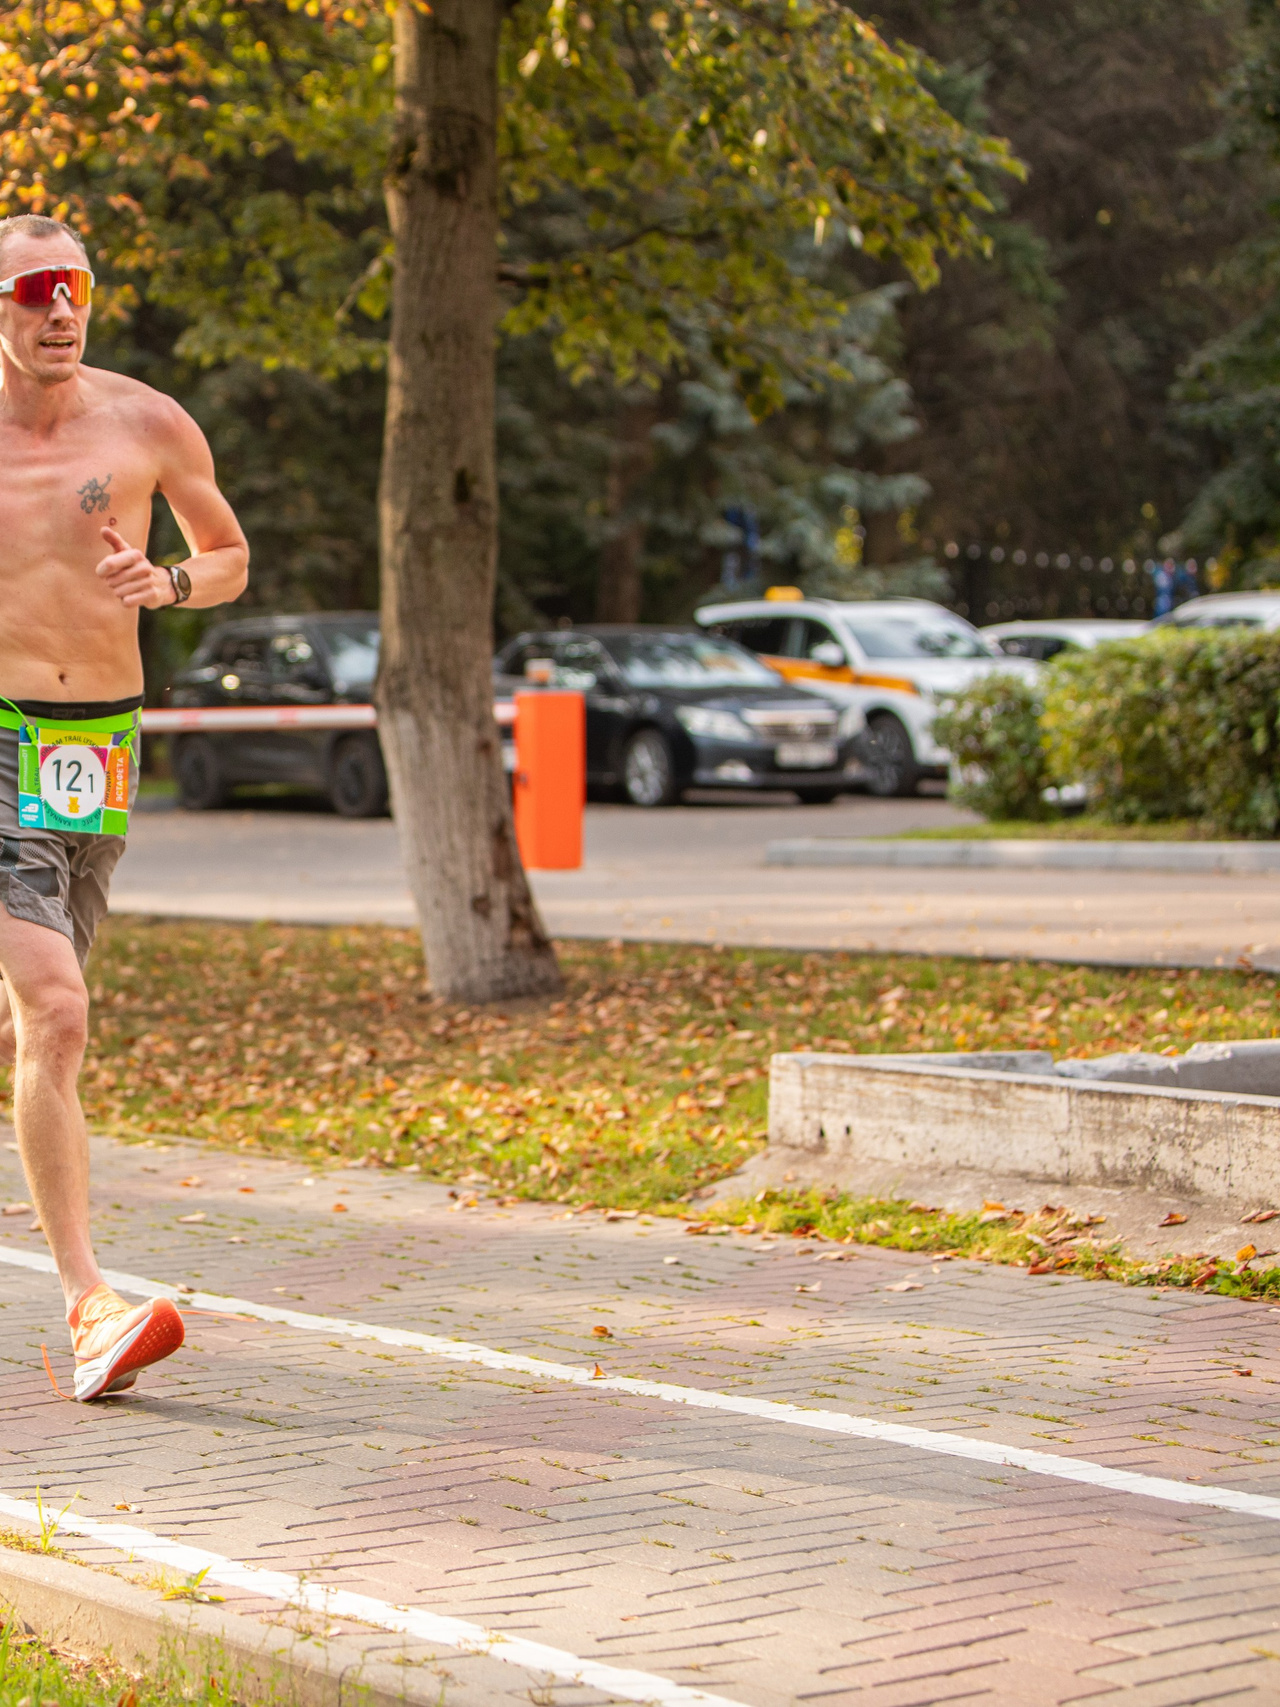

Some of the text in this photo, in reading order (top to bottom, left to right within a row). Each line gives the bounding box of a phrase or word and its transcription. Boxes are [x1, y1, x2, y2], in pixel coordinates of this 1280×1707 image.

[41, 735, 105, 760] DREAM TRAIL LYSKOVO
[116, 757, 124, 802] ЭСТАФЕТА
[46, 808, 71, 827] KANNAS
